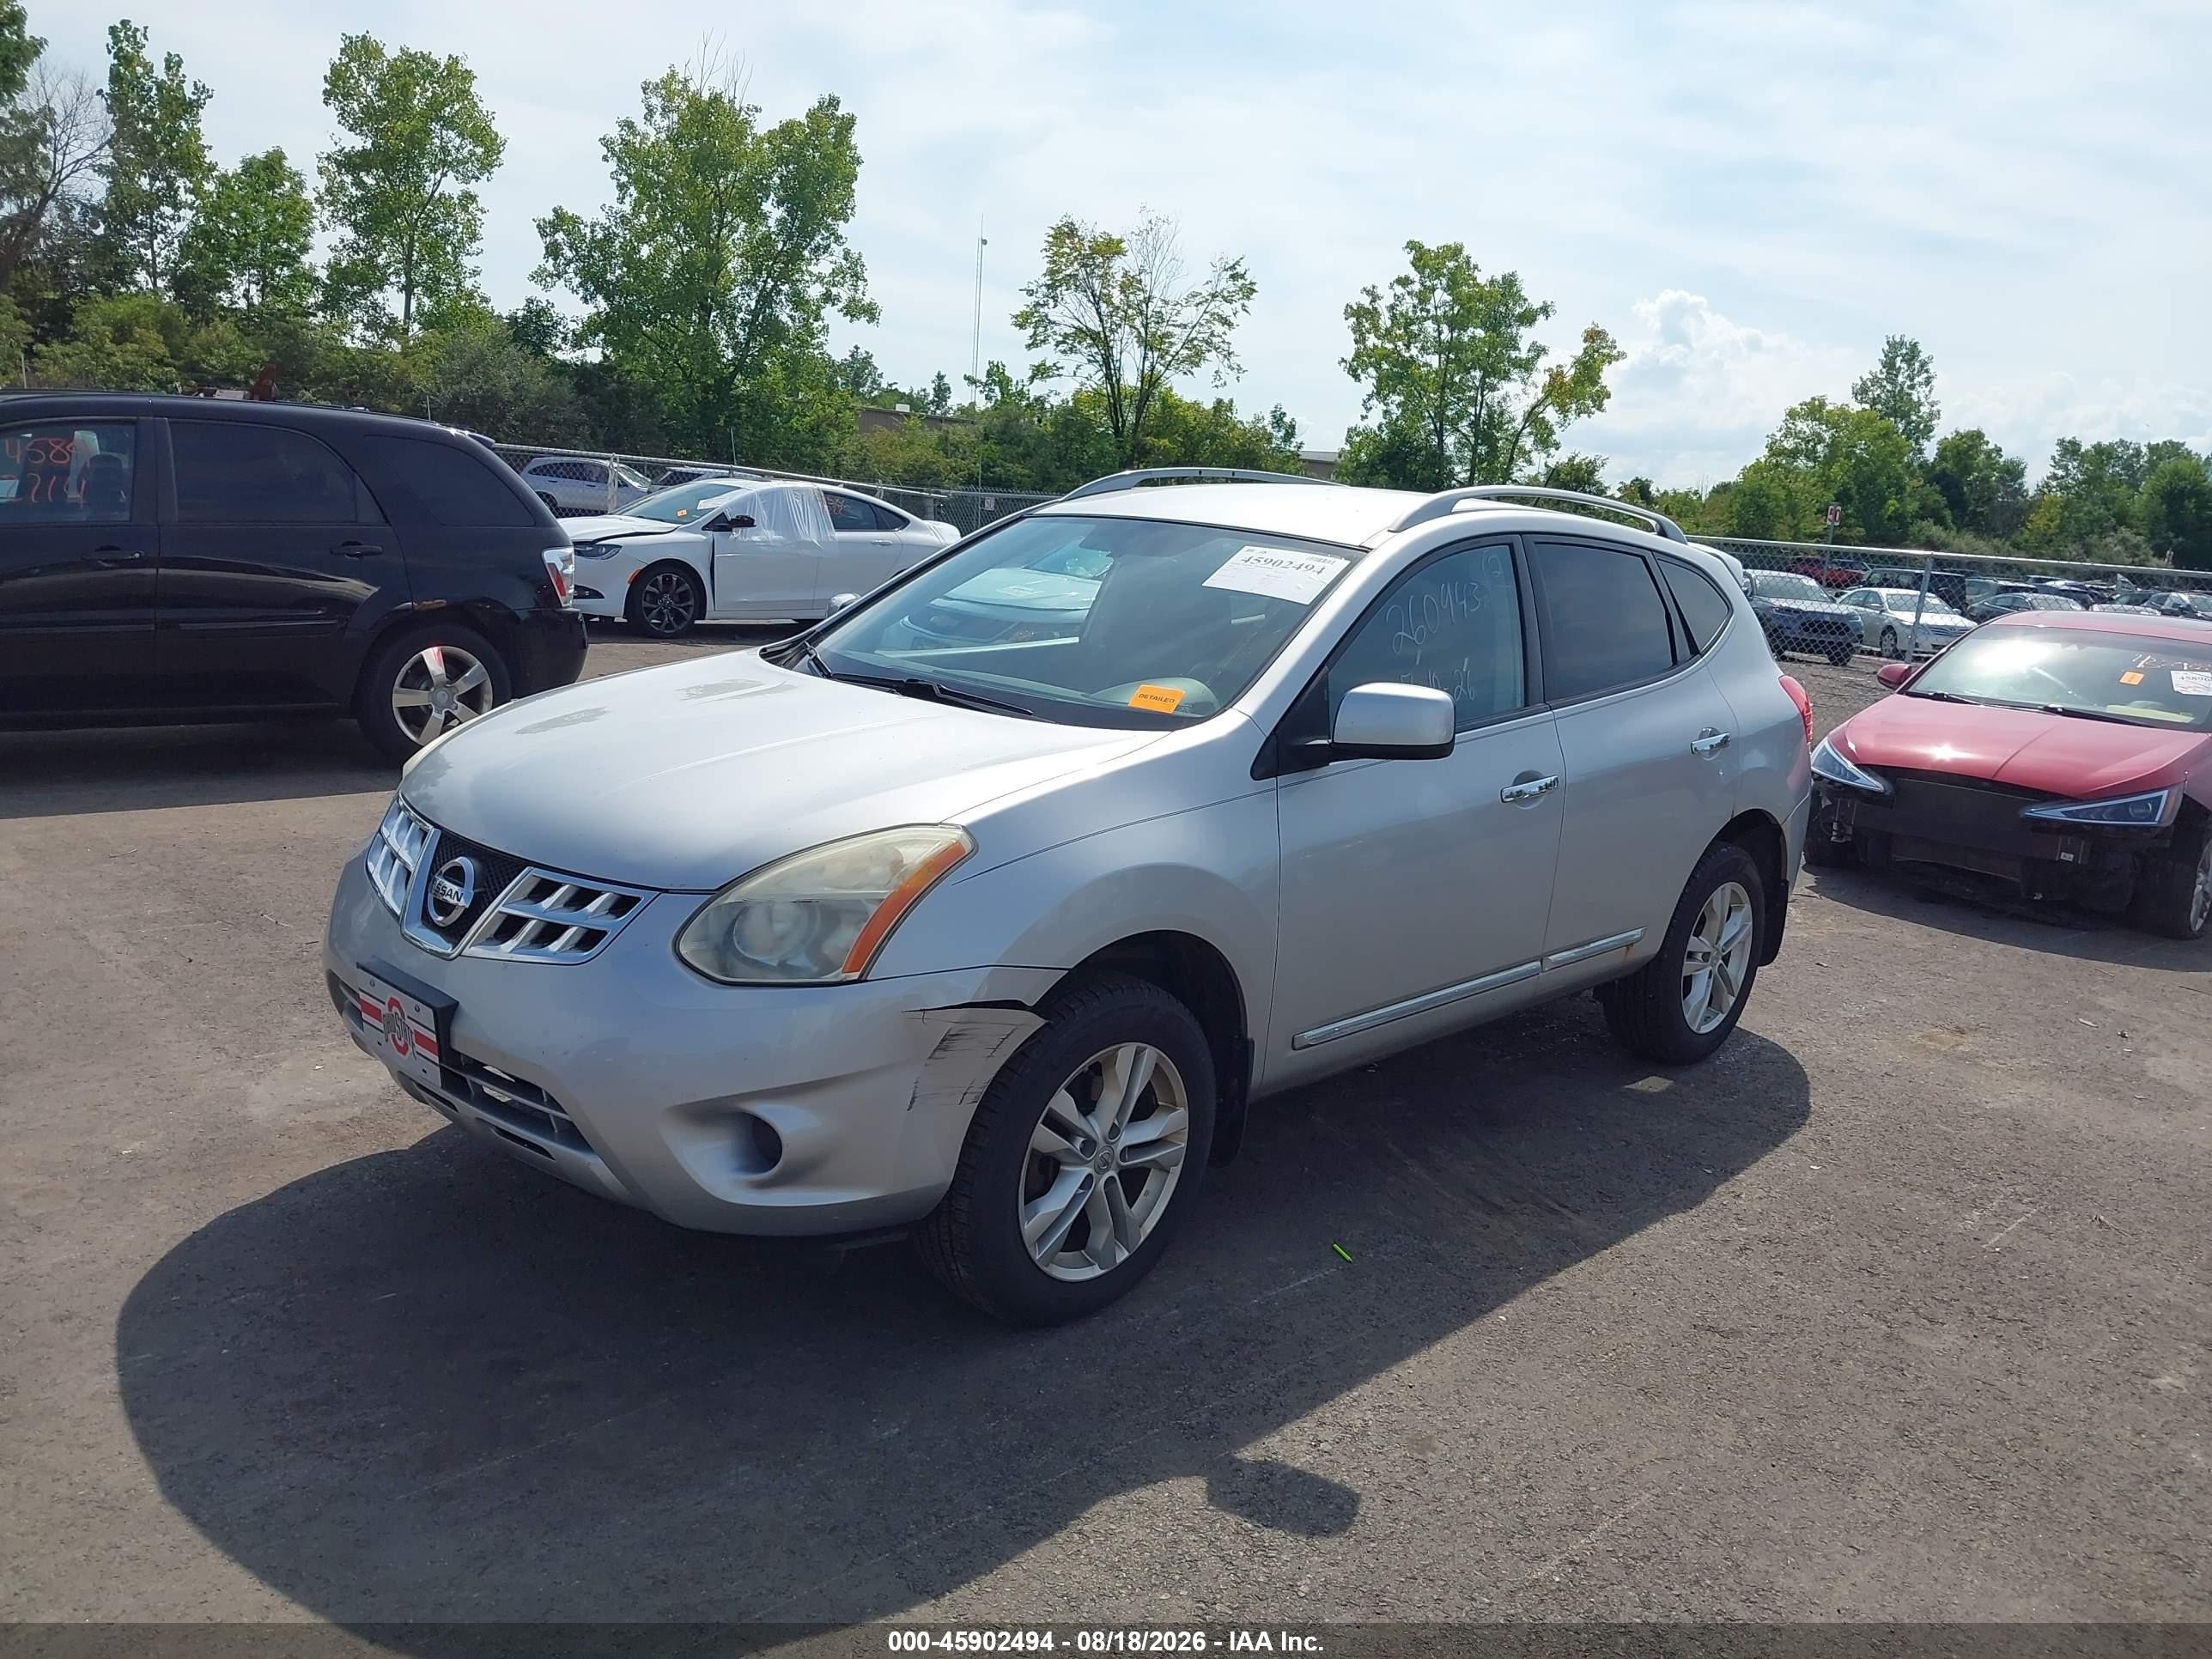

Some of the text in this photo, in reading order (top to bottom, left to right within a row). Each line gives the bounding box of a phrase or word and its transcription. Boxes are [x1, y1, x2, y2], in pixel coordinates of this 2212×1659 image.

[1241, 556, 1326, 575] 45902494
[1386, 581, 1481, 654] 260943
[1139, 693, 1175, 703] DETAILED
